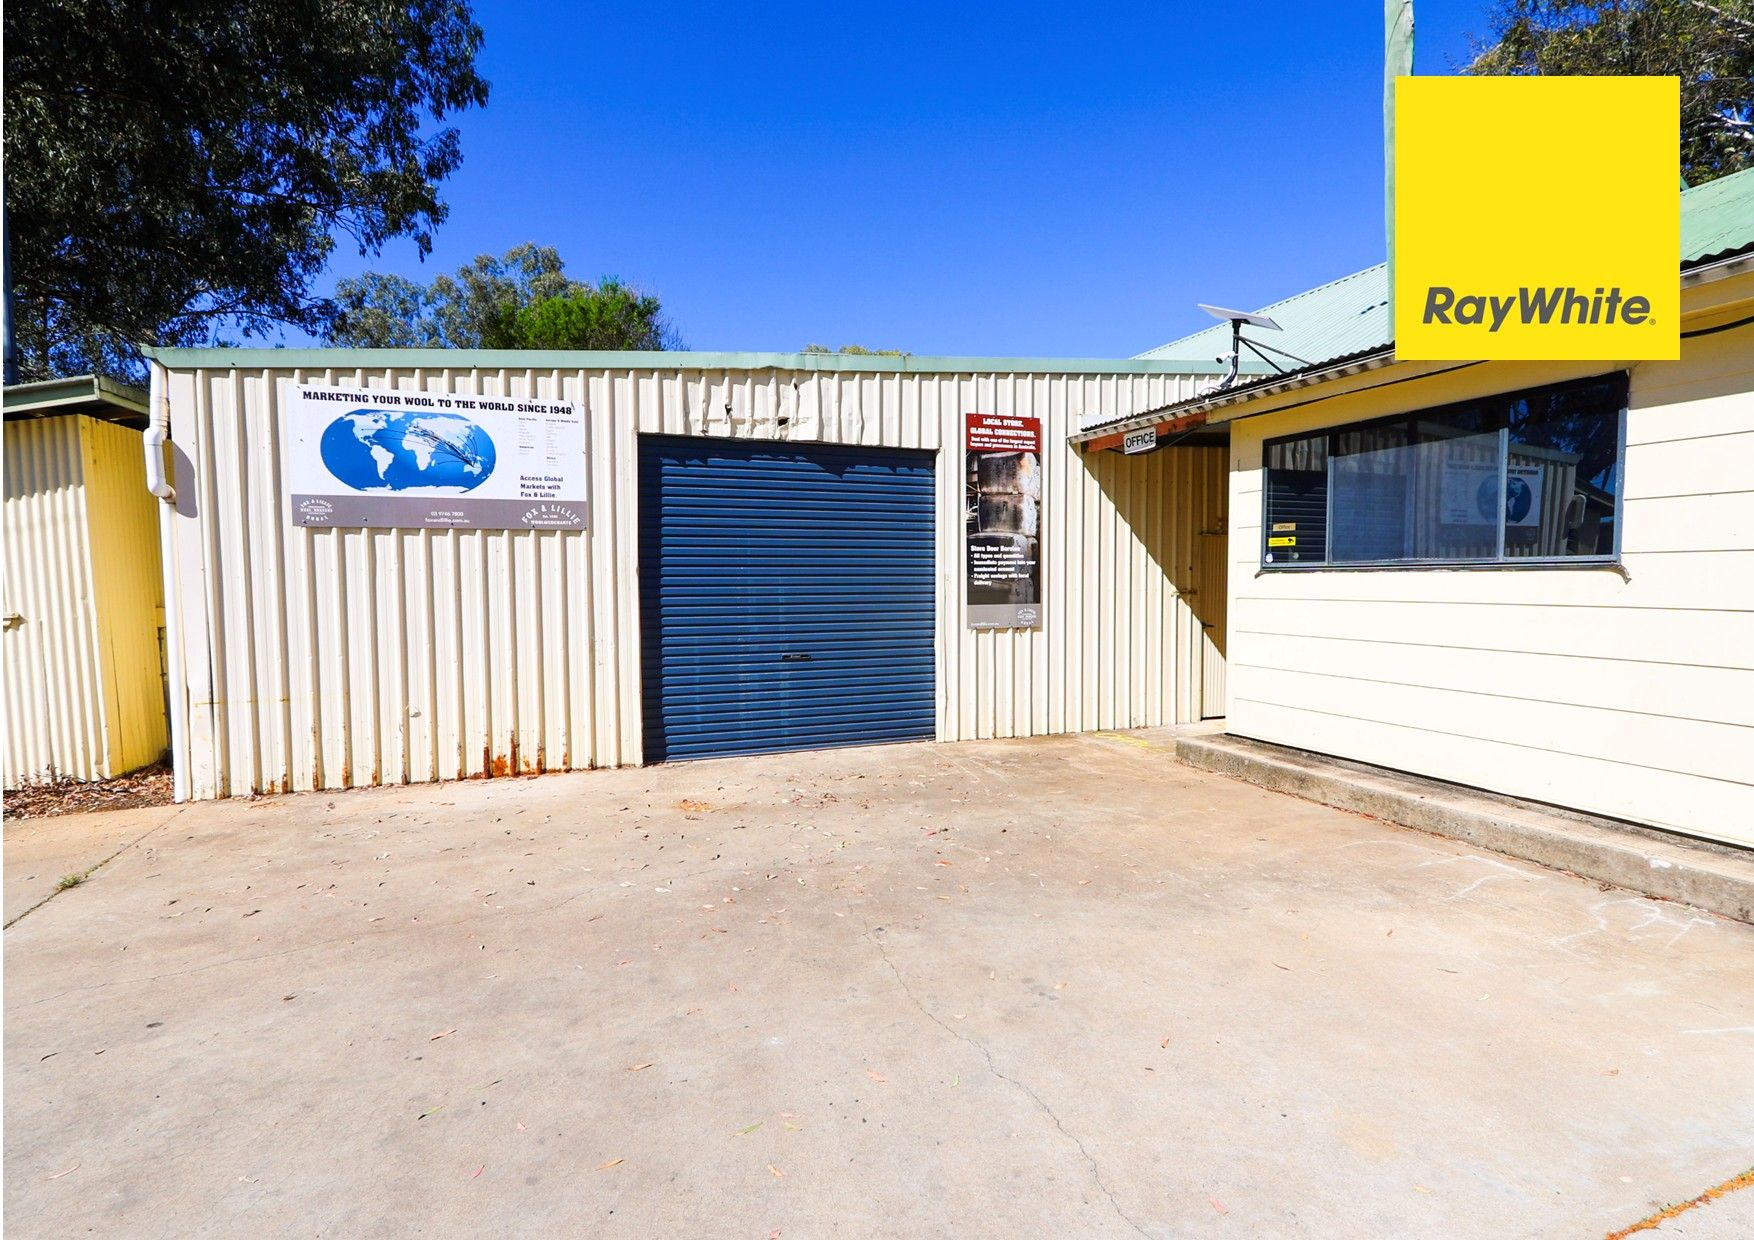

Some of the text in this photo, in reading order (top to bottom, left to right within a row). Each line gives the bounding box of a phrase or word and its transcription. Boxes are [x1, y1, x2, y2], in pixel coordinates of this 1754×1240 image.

[303, 391, 572, 415] MARKETING YOUR WOOL TO THE WORLD SINCE 1948
[983, 418, 1002, 426] LOCAL
[970, 427, 993, 435] GLOBAL
[1125, 431, 1155, 448] OFFICE
[521, 508, 539, 524] FOX
[551, 504, 580, 525] LILLIE
